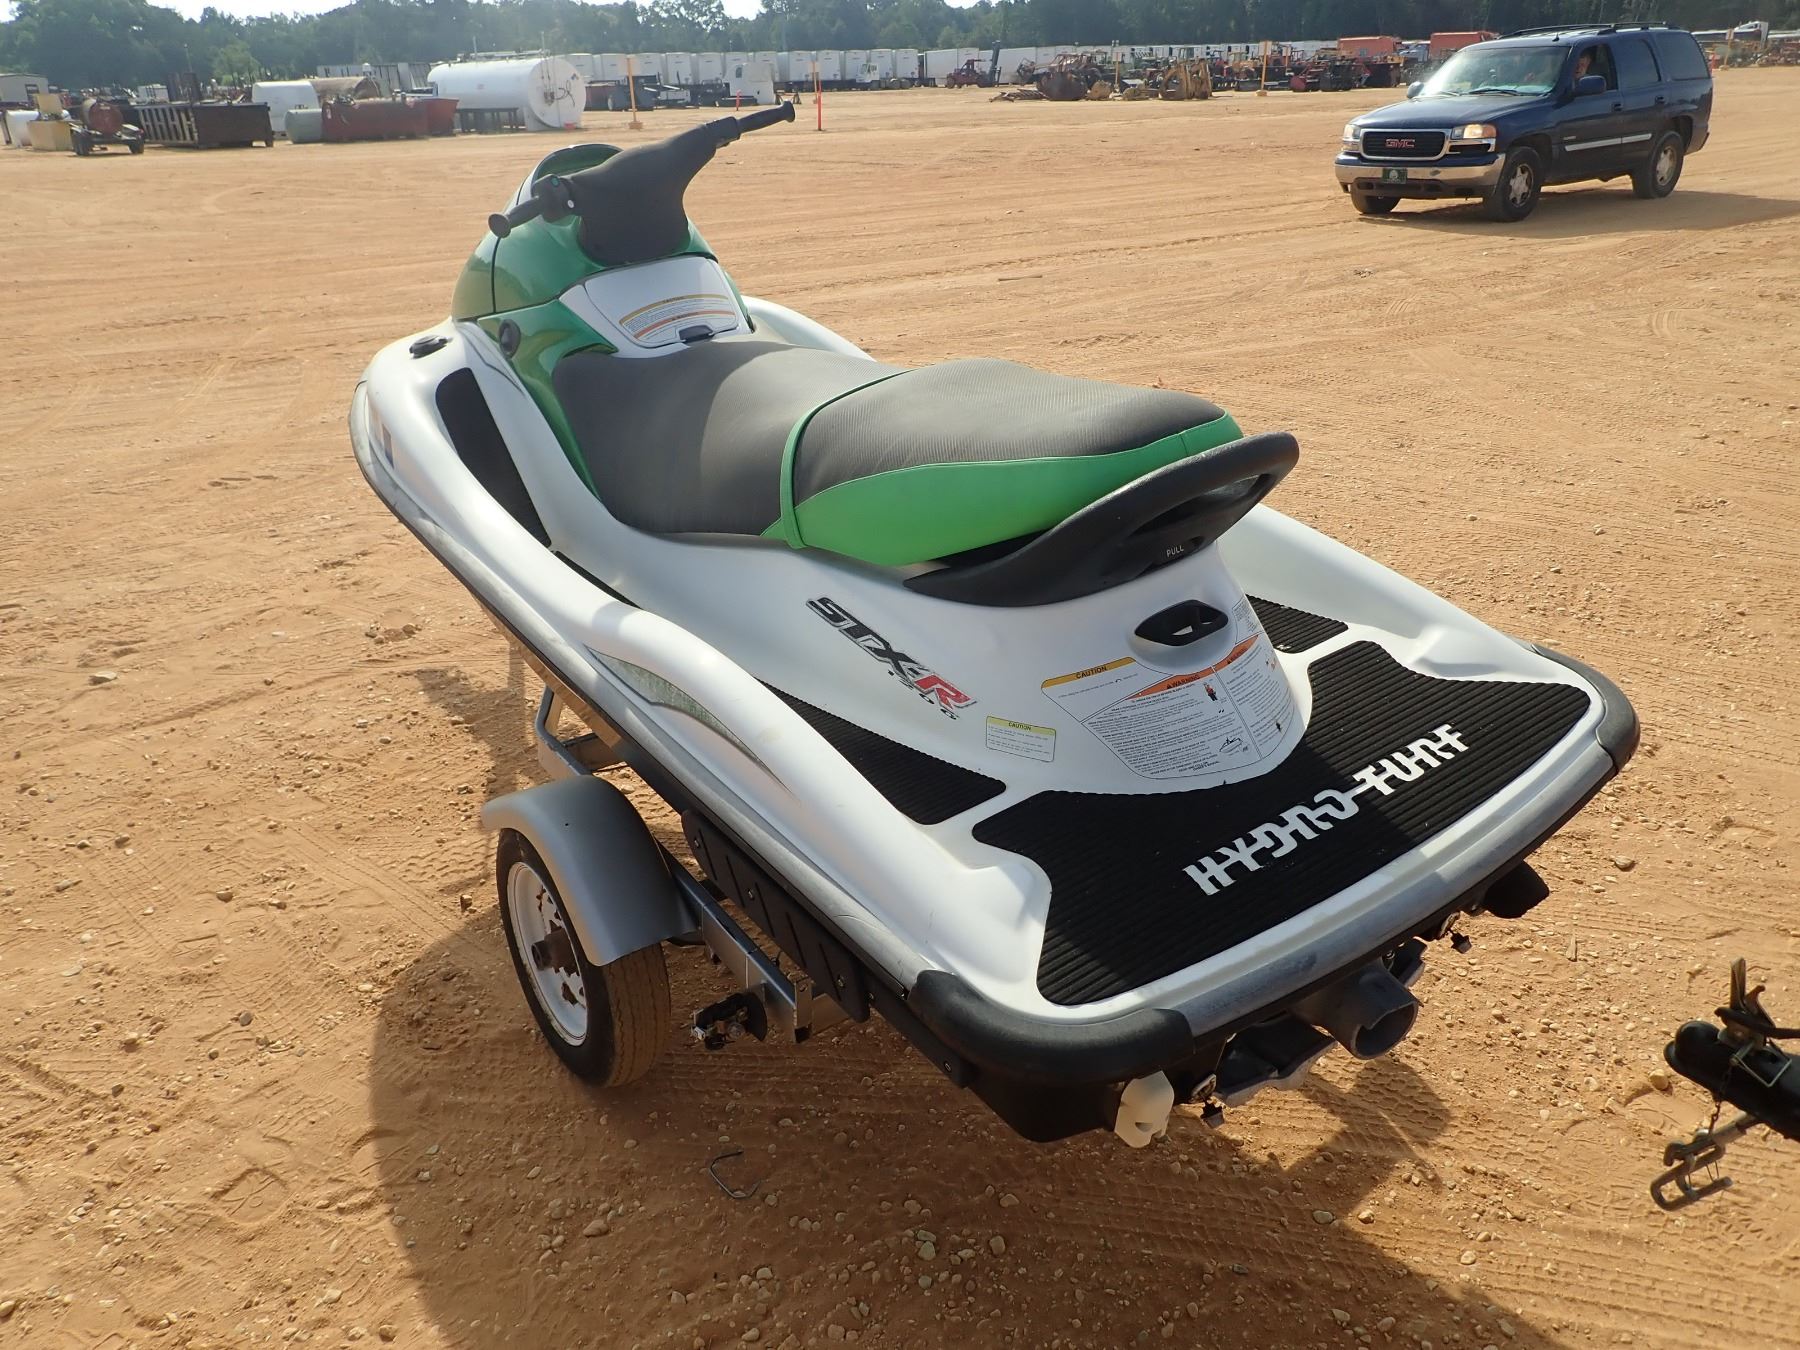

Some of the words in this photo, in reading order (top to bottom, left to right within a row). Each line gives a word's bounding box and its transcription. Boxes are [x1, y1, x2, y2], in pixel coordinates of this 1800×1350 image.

[1385, 138, 1416, 148] GMC
[1166, 545, 1185, 558] PULL
[1075, 665, 1108, 680] CAUTION
[1008, 721, 1032, 731] CAUTION
